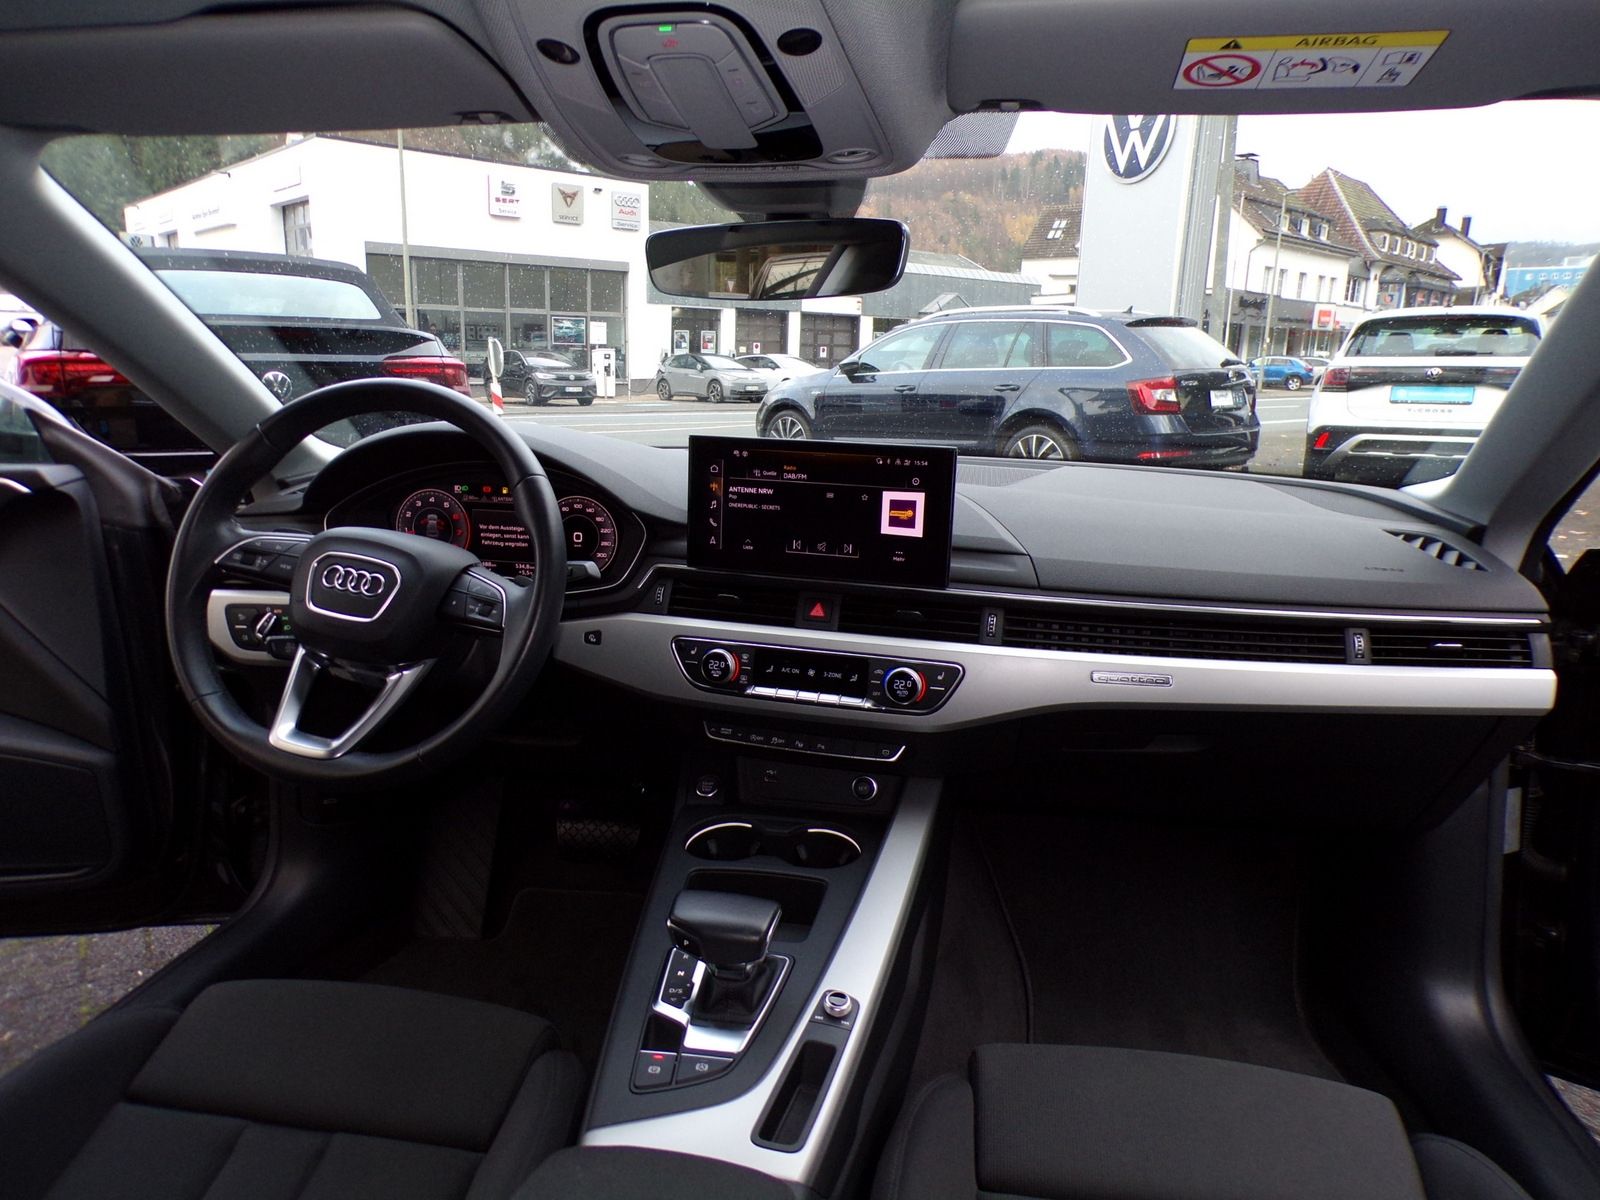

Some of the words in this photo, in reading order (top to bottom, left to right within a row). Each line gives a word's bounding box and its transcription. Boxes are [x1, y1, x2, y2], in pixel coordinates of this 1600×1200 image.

[1295, 34, 1378, 47] AIRBAG
[618, 208, 637, 216] Audi
[728, 486, 757, 494] ANTENNE
[728, 502, 759, 510] ONEREPUBLIC
[573, 532, 583, 543] 0
